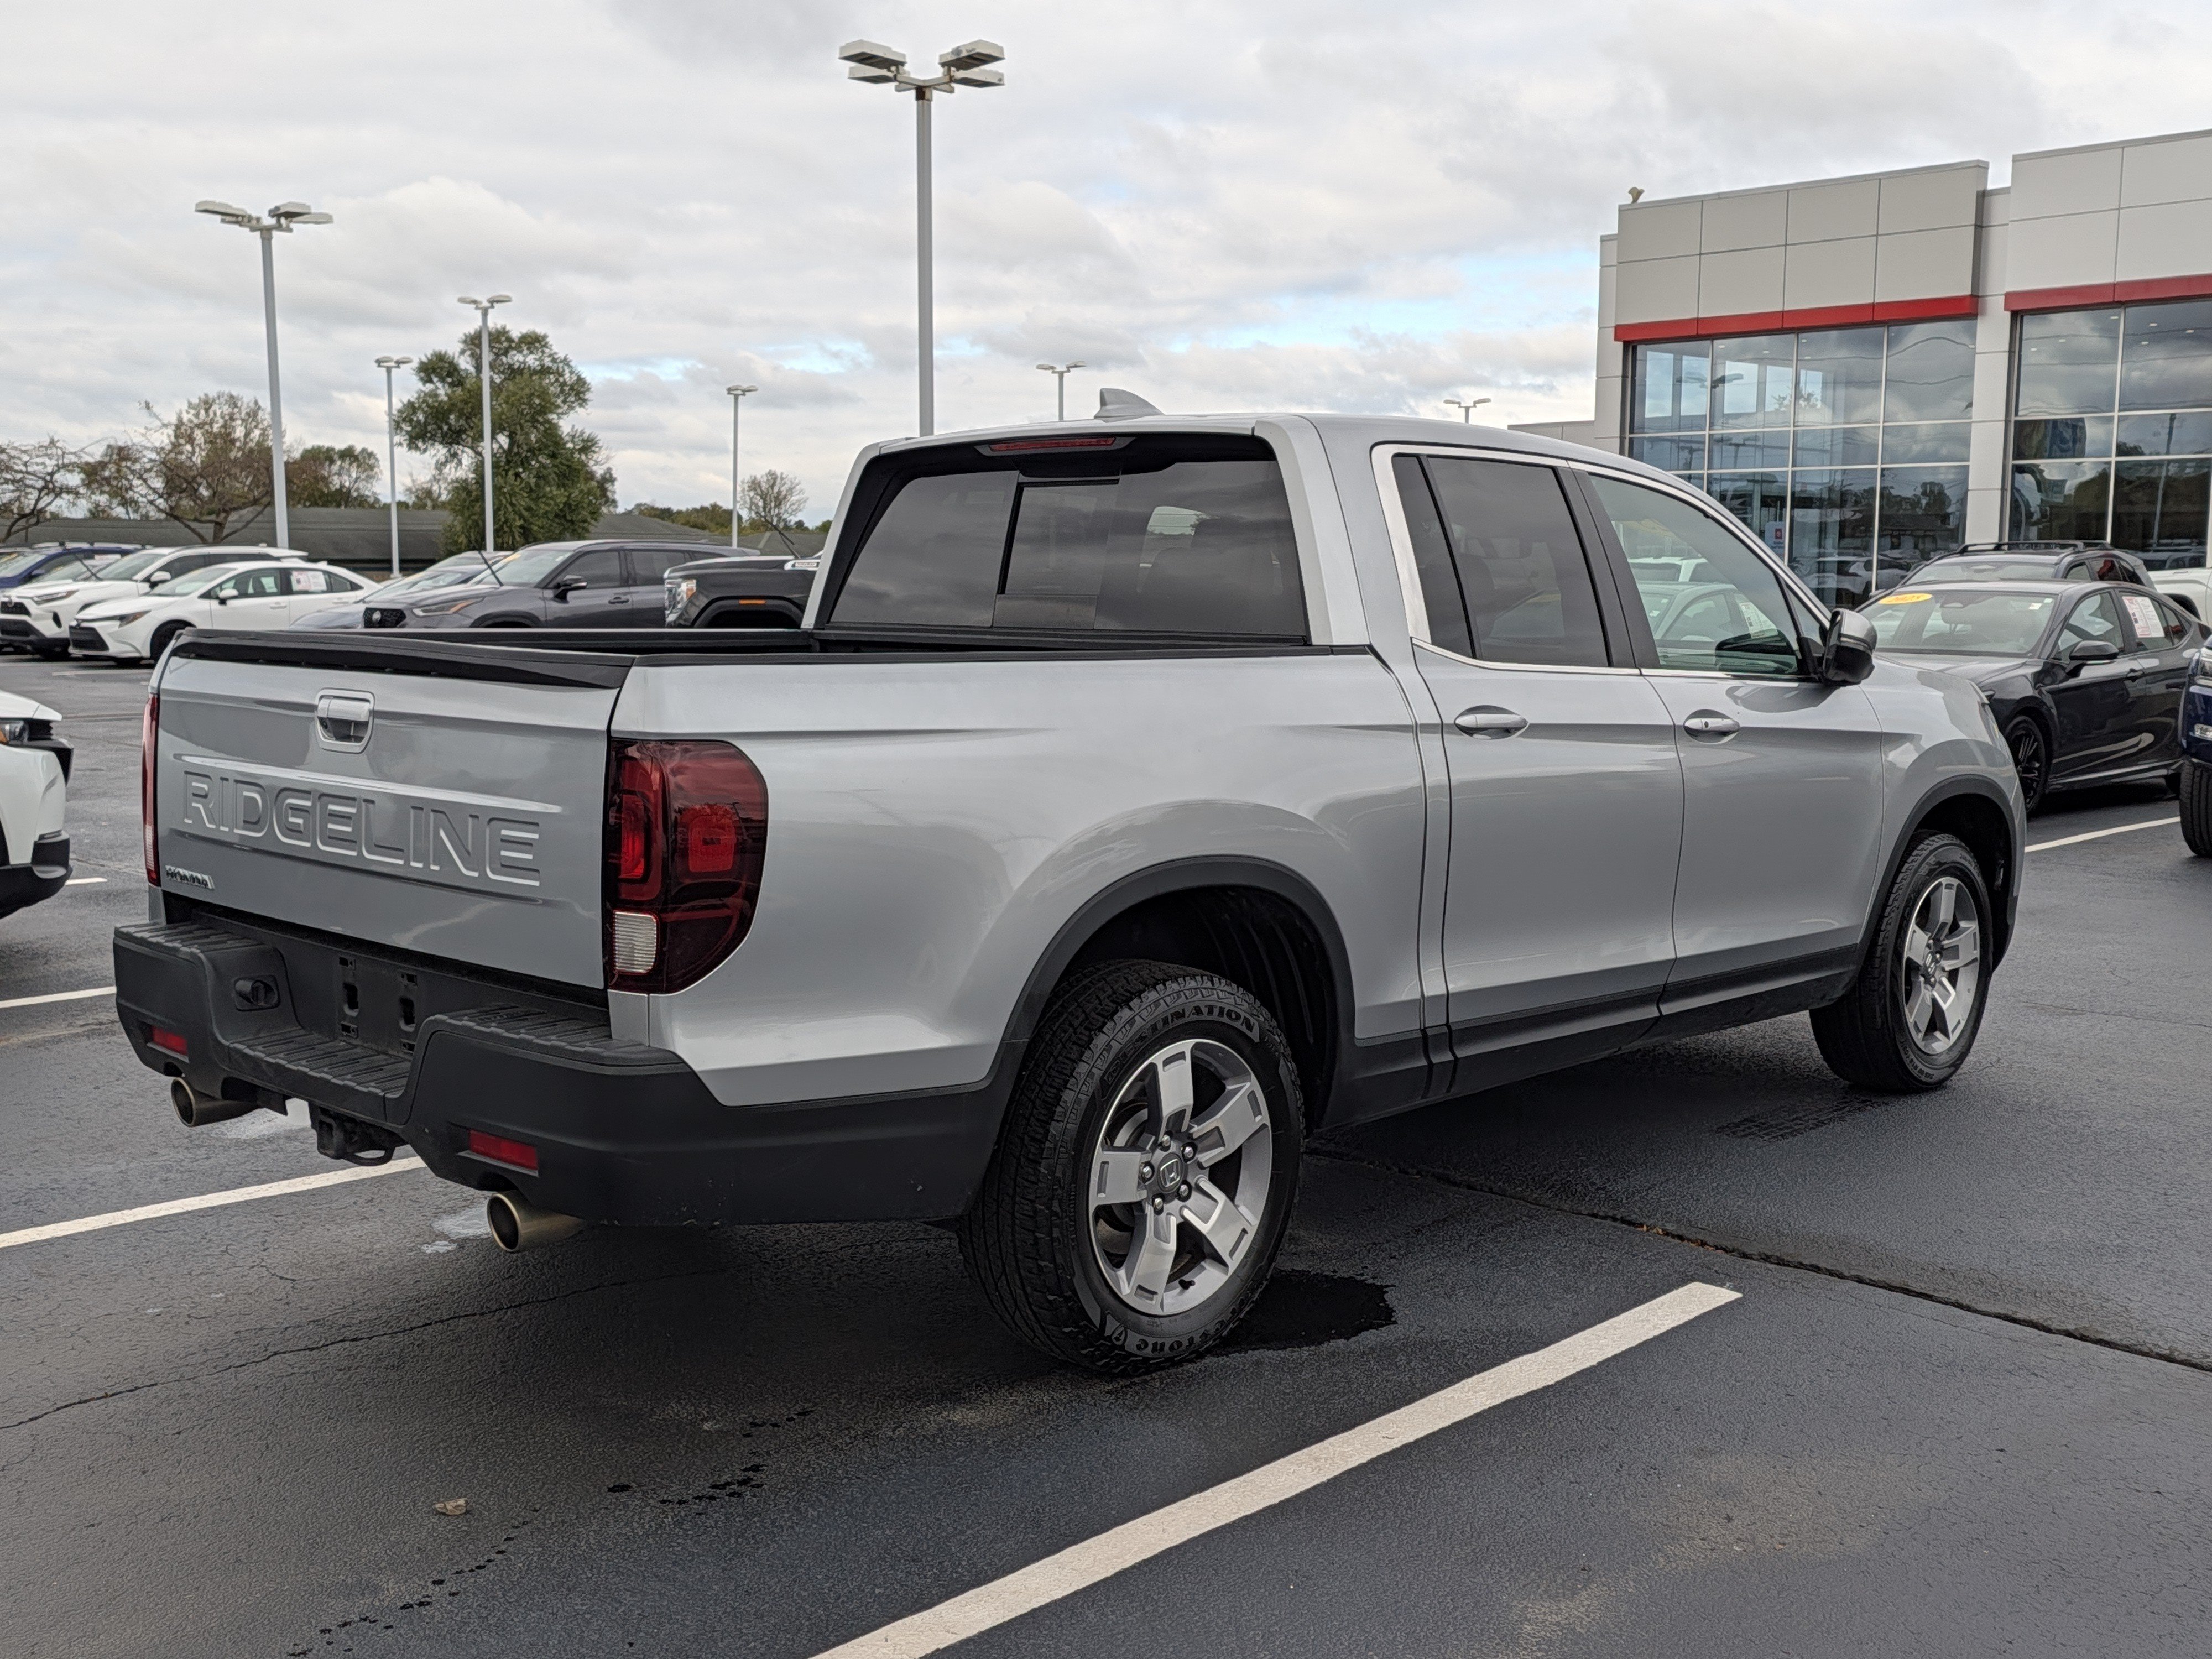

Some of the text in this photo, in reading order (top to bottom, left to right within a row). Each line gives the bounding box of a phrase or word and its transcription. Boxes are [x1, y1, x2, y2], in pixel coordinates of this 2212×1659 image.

[184, 770, 540, 886] RIDGELINE
[165, 864, 215, 890] HONDA
[1105, 1005, 1256, 1084] DESTINATION
